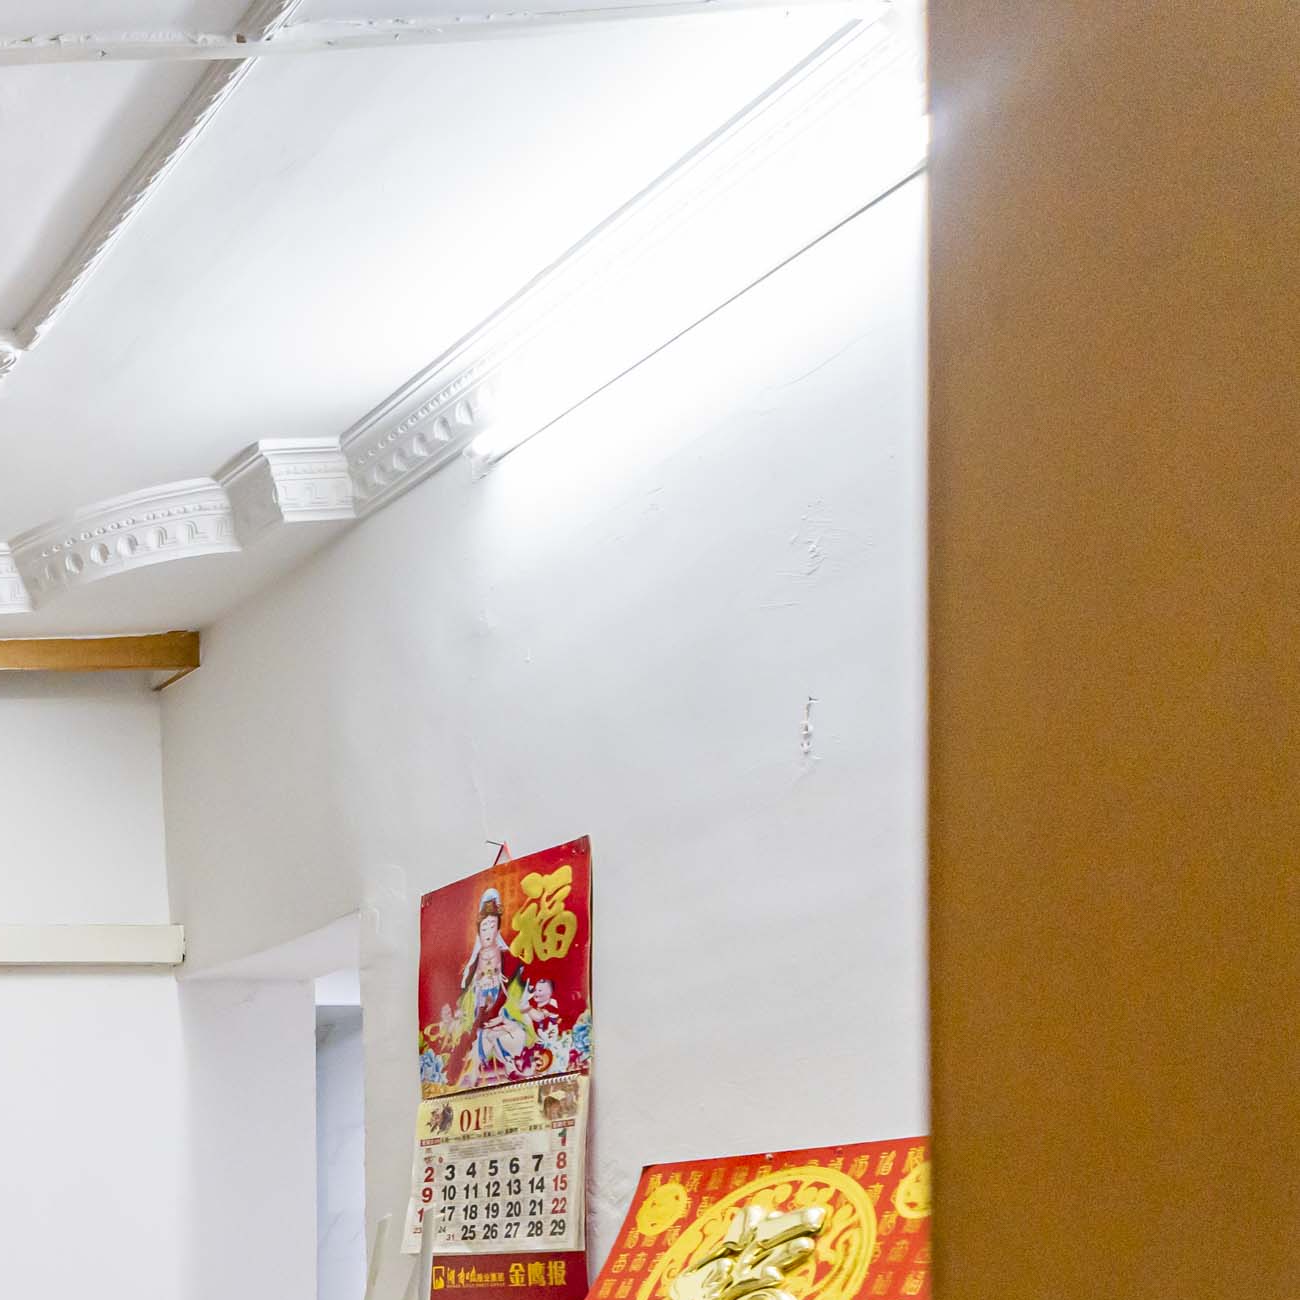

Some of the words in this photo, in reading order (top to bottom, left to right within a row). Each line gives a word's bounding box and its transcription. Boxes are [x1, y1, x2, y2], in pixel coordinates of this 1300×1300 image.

[510, 865, 577, 964] 福
[460, 1106, 482, 1132] 01
[558, 1128, 567, 1146] 1
[424, 1167, 434, 1183] 2
[444, 1165, 456, 1181] 3
[466, 1162, 476, 1178] 4
[488, 1160, 498, 1176] 5
[509, 1158, 520, 1174] 6
[532, 1154, 544, 1172] 7
[556, 1152, 567, 1169] 8
[422, 1188, 433, 1203] 9
[442, 1185, 456, 1200] 10
[464, 1184, 478, 1199] 11
[486, 1181, 500, 1198] 12
[506, 1179, 522, 1195] 13
[528, 1176, 544, 1193] 14
[552, 1174, 568, 1191] 15
[418, 1208, 424, 1223] 1
[462, 1204, 478, 1220] 18
[485, 1202, 500, 1218] 19
[506, 1201, 522, 1217] 20
[529, 1199, 544, 1216] 21
[551, 1197, 566, 1214] 22
[461, 1225, 476, 1240] 25
[483, 1224, 498, 1239] 26
[504, 1222, 520, 1238] 27
[527, 1221, 543, 1237] 28
[550, 1219, 566, 1236] 29
[508, 1260, 568, 1287] 金鹰报
